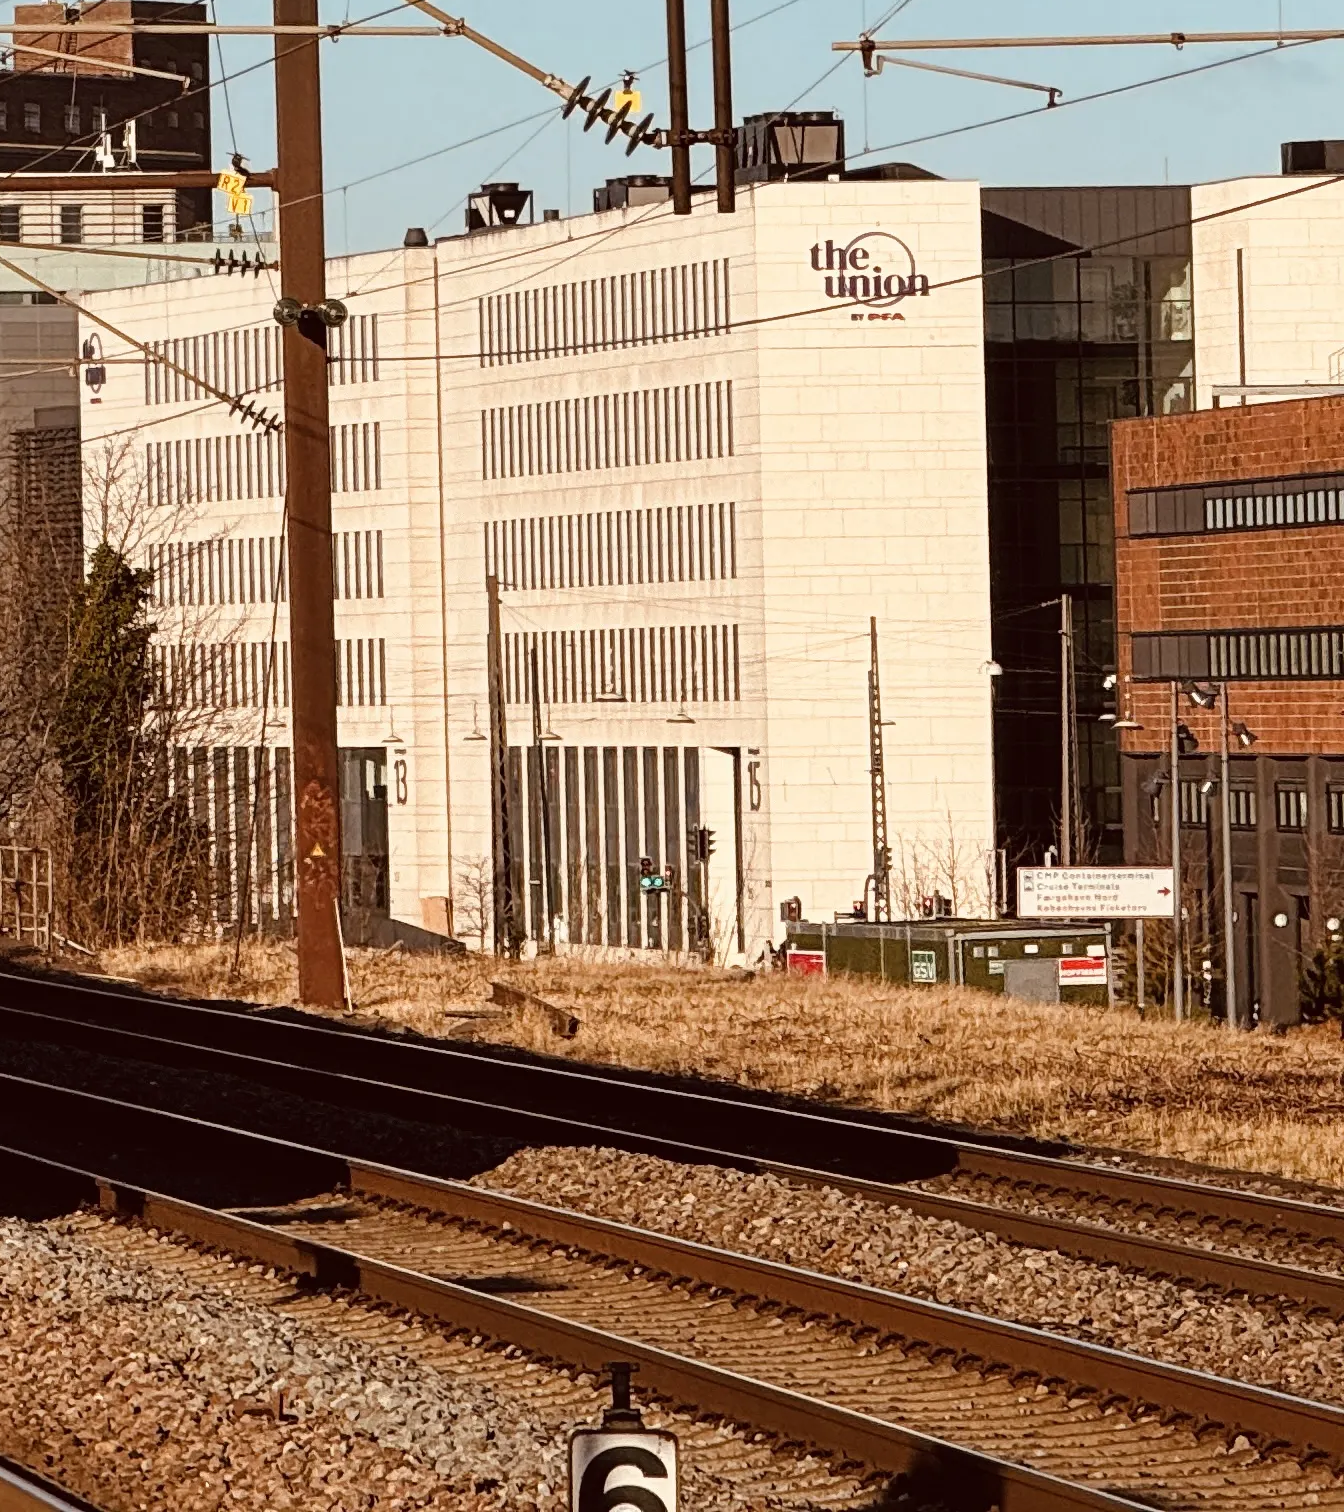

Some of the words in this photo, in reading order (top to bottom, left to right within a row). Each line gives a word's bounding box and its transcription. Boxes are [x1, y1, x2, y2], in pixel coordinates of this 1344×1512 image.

[221, 175, 240, 196] R2
[809, 239, 870, 271] the
[824, 265, 930, 298] union
[393, 759, 408, 805] 13
[747, 761, 762, 812] 15
